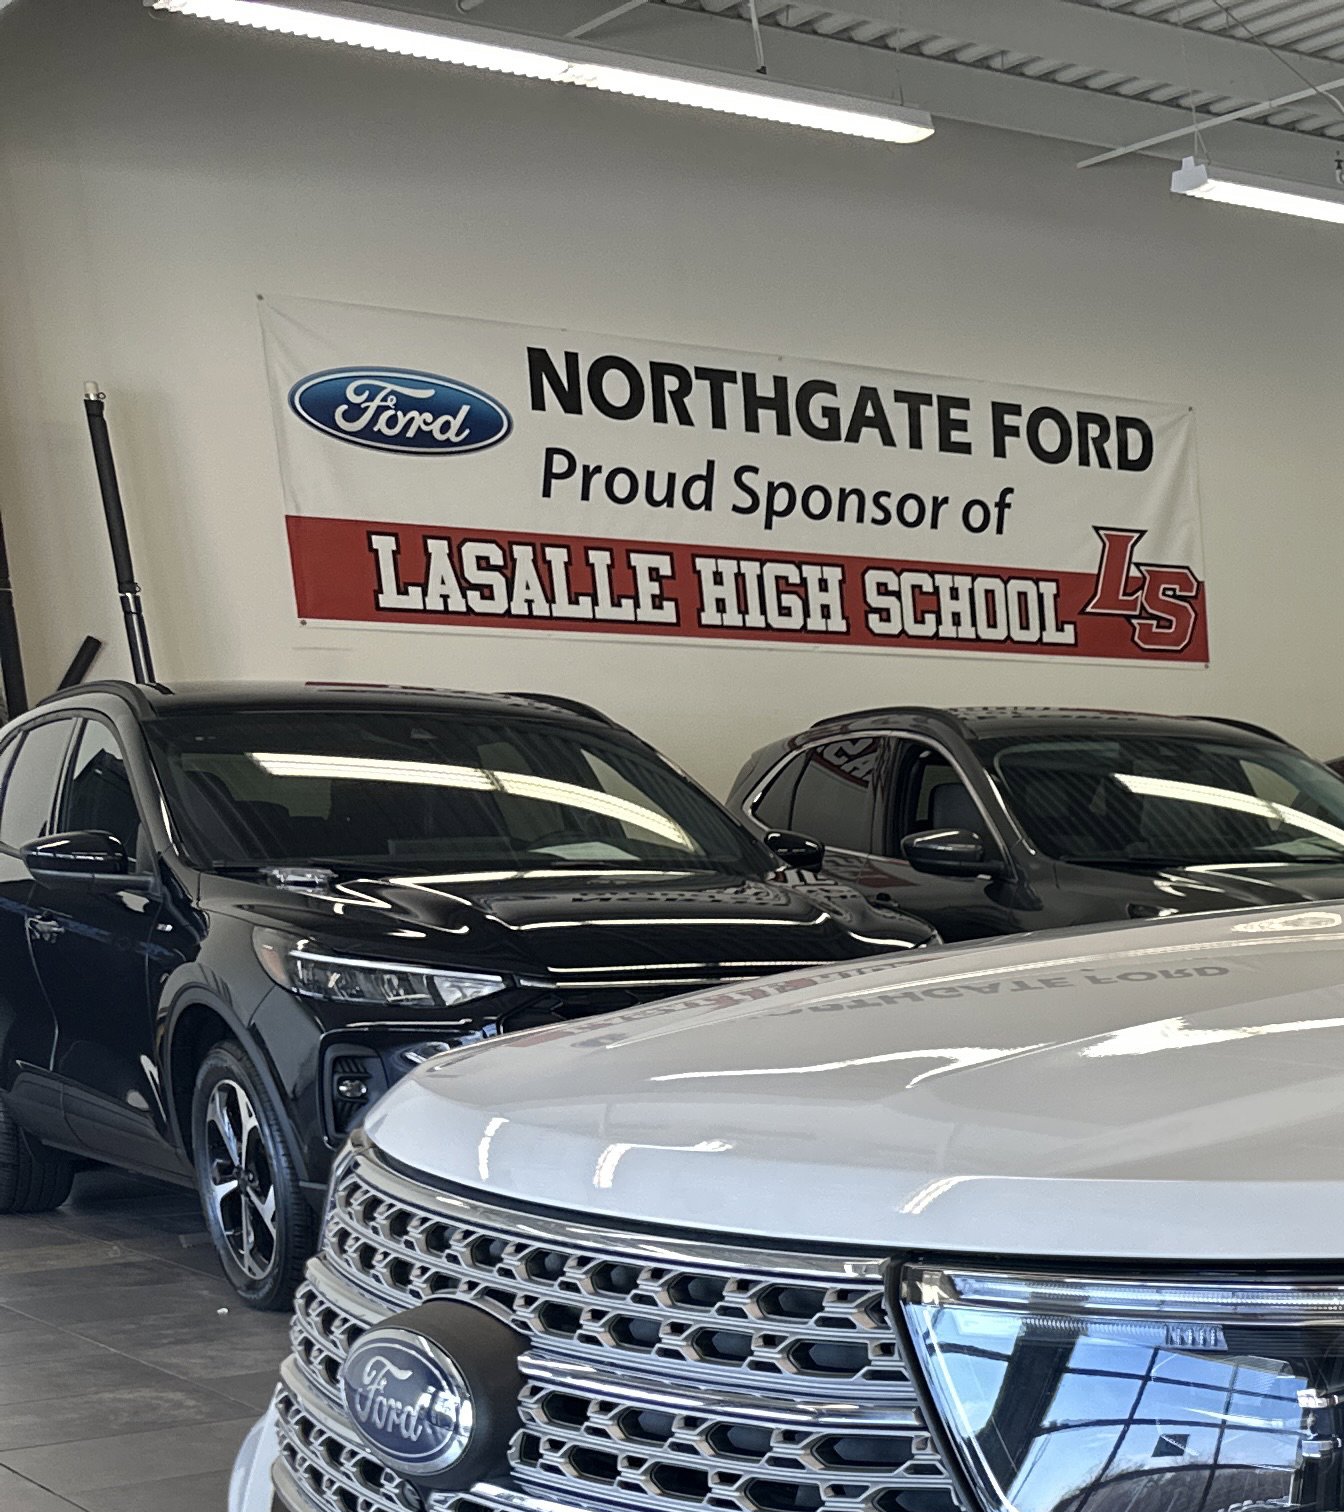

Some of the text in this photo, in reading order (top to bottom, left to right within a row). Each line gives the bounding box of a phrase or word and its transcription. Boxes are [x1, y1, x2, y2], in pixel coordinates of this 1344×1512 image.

[334, 378, 470, 444] Ford
[527, 346, 1153, 472] NORTHGATE FORD
[542, 447, 1014, 535] Proud Sponsor of
[368, 532, 1077, 647] LASALLE HIGH SCHOOL
[1079, 525, 1200, 653] LS
[354, 1355, 424, 1442] Ford
